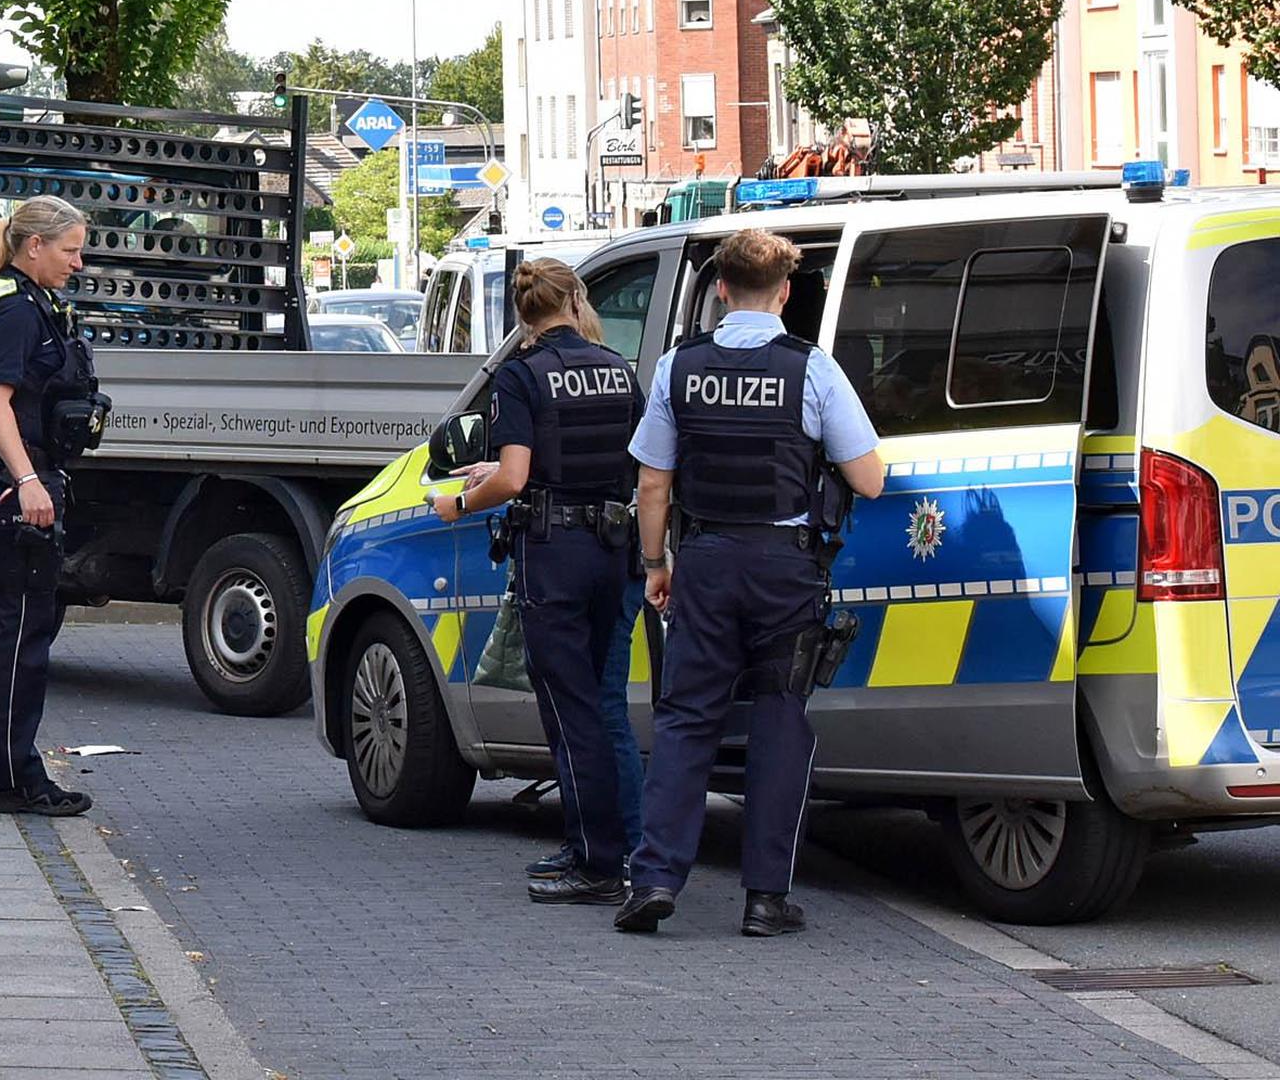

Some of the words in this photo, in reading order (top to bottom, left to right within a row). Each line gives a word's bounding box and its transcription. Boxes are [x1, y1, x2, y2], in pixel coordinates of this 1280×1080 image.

[355, 116, 397, 130] ARAL
[606, 138, 636, 152] Birk
[547, 368, 632, 399] POLIZEI
[686, 374, 785, 407] POLIZEI
[105, 411, 147, 429] aletten
[163, 412, 216, 433] Spezial-,
[221, 414, 296, 438] Schwergut-
[300, 416, 326, 435] und
